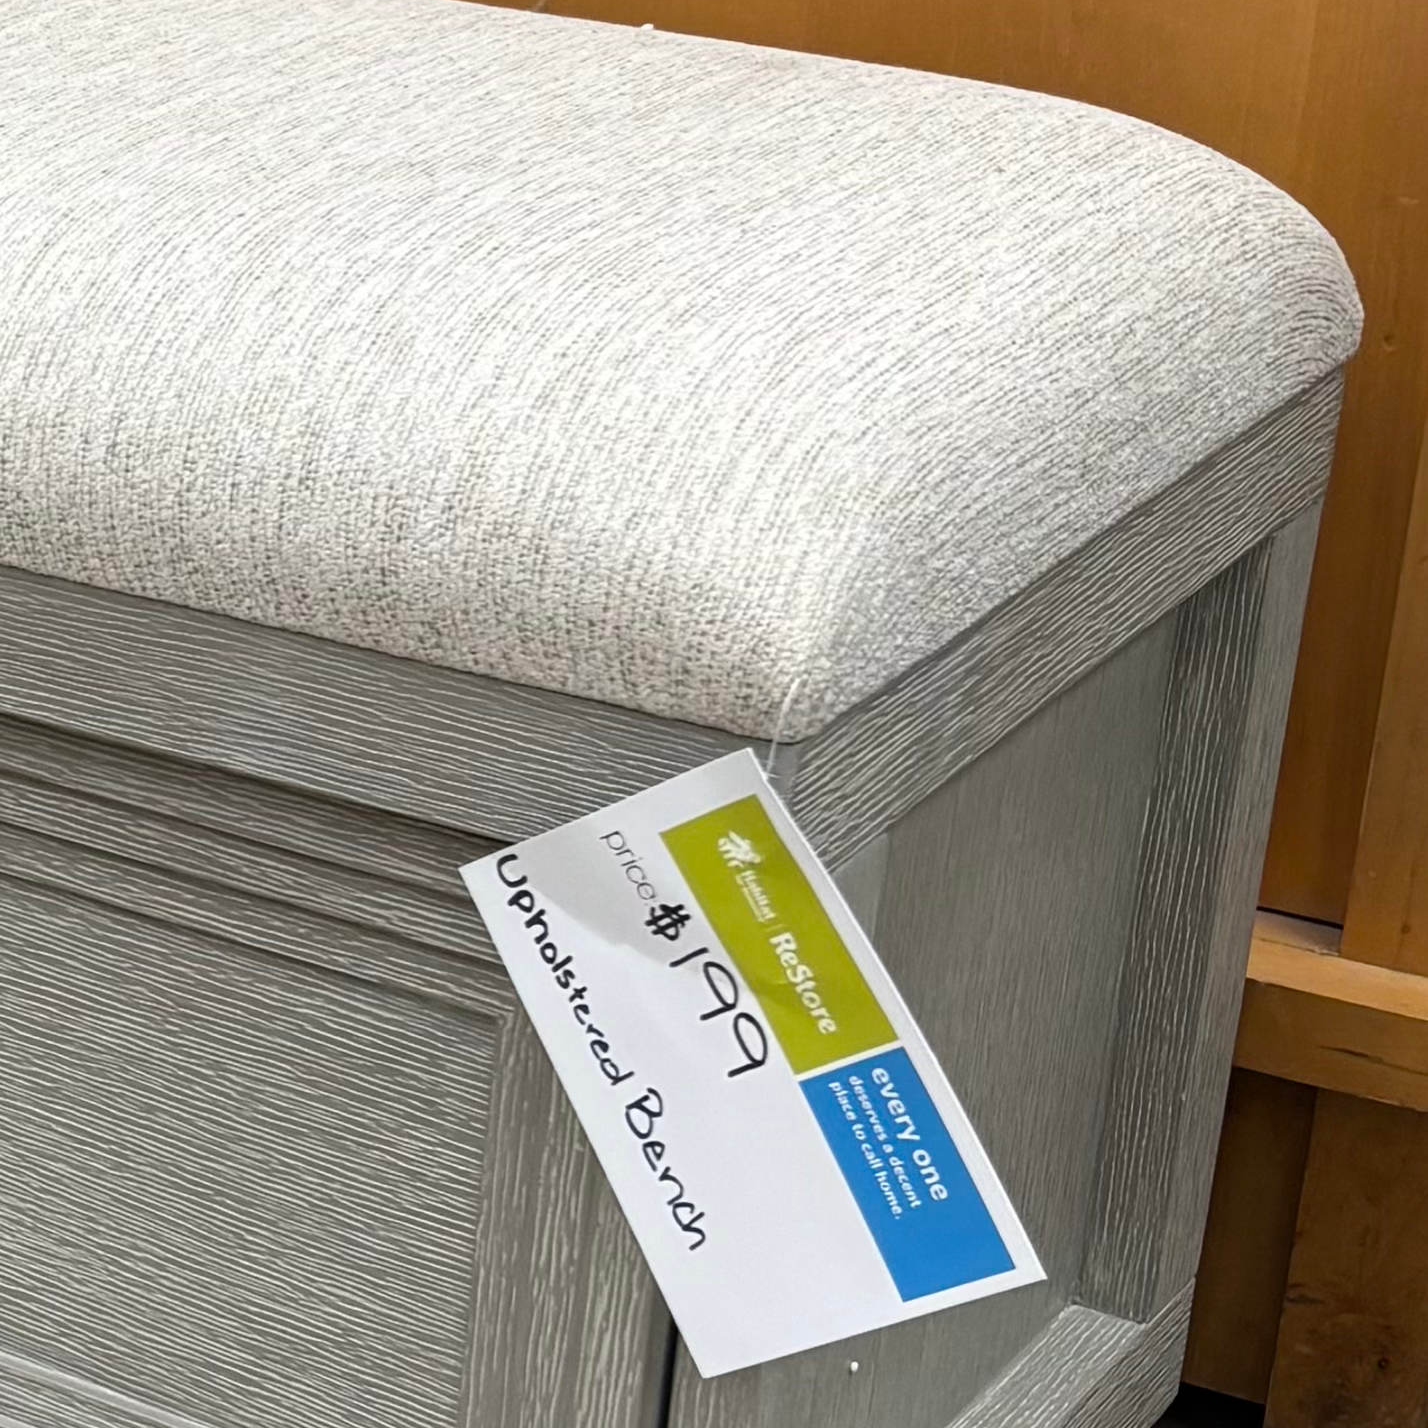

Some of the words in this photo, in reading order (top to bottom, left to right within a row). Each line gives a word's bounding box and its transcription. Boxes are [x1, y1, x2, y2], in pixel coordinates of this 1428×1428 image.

[769, 932, 837, 1035] ReStore
[625, 1087, 707, 1251] Bench
[828, 1081, 857, 1121] place
[852, 1123, 867, 1140] to
[861, 1142, 884, 1169] call
[874, 1171, 903, 1220] home.
[848, 1075, 888, 1141] deserves
[882, 1143, 893, 1154] a
[888, 1156, 922, 1208] decent
[871, 1067, 921, 1141] every
[912, 1149, 948, 1201] one
